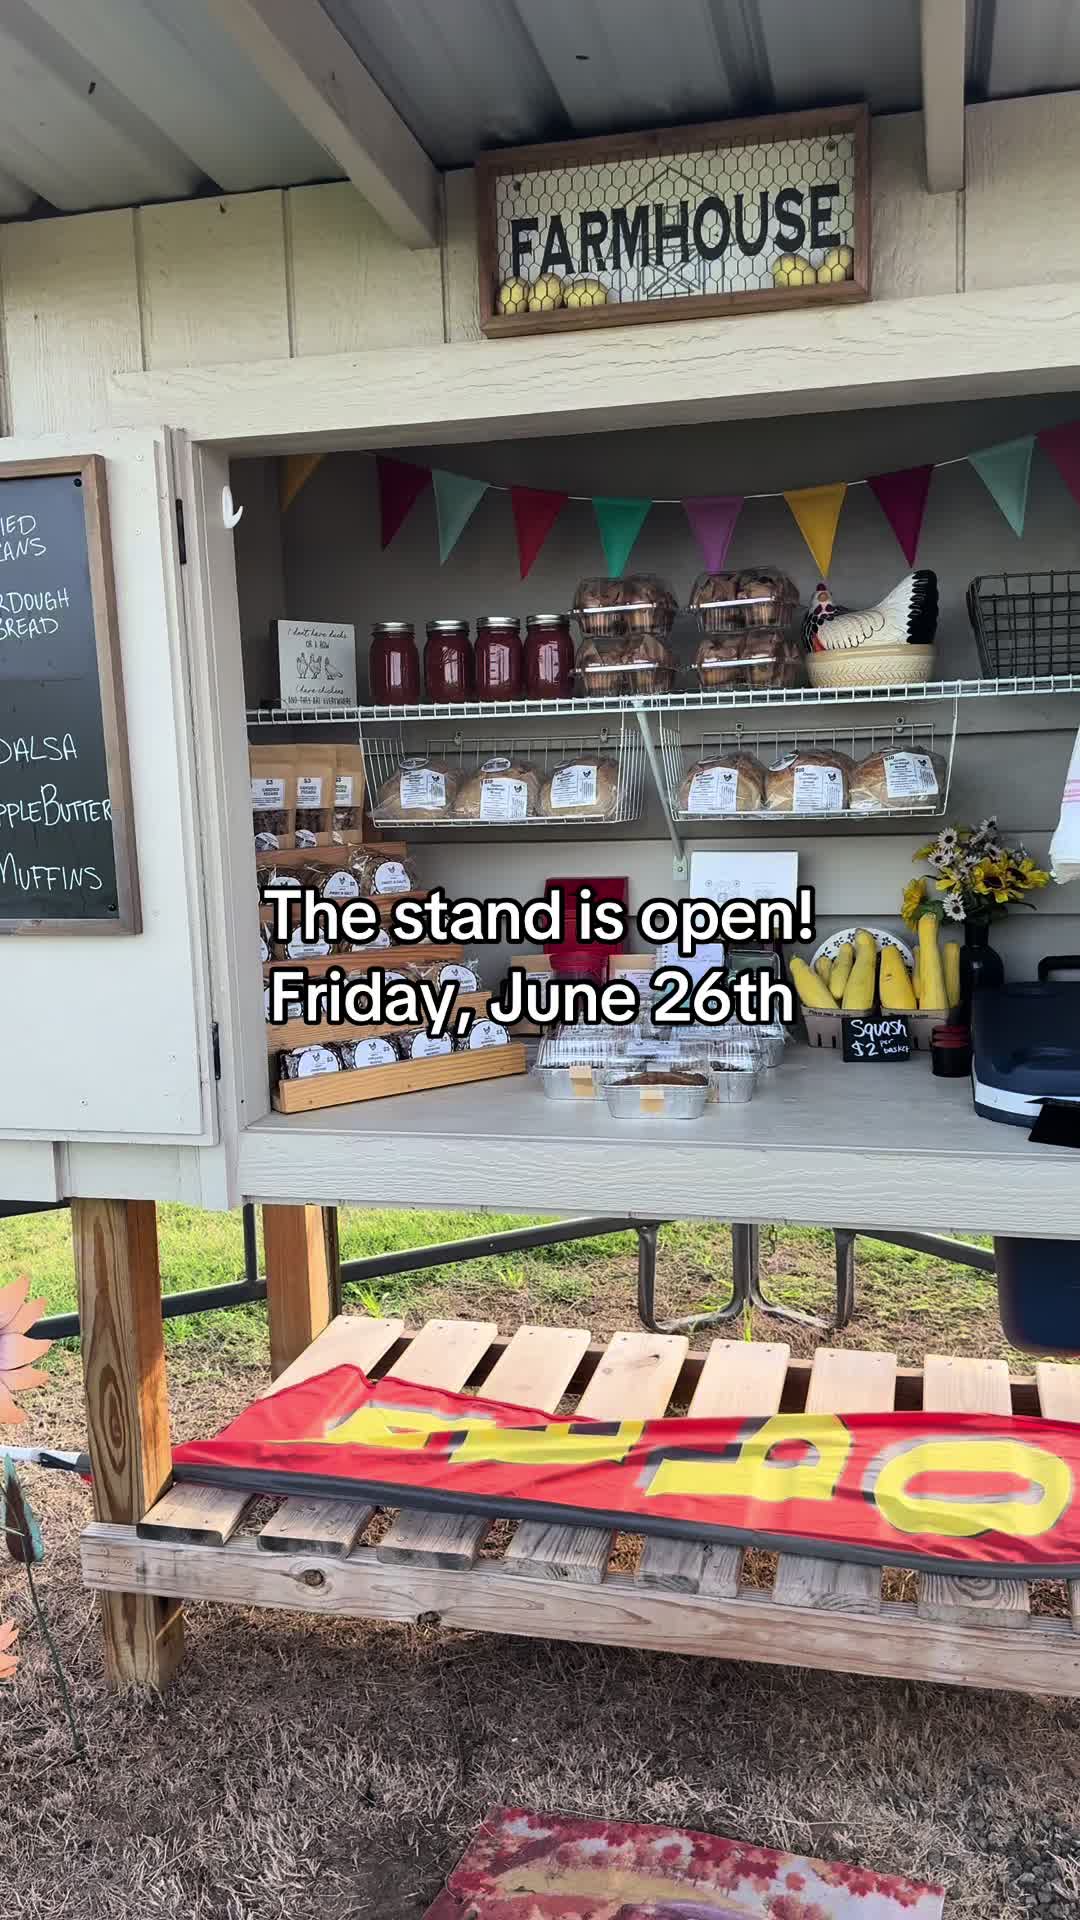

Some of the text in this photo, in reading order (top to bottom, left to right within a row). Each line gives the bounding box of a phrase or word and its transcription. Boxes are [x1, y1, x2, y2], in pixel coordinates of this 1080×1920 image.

[510, 183, 841, 278] FARMHOUSE
[851, 1019, 907, 1041] Squash
[851, 1041, 879, 1056] $2
[884, 1045, 909, 1054] basket
